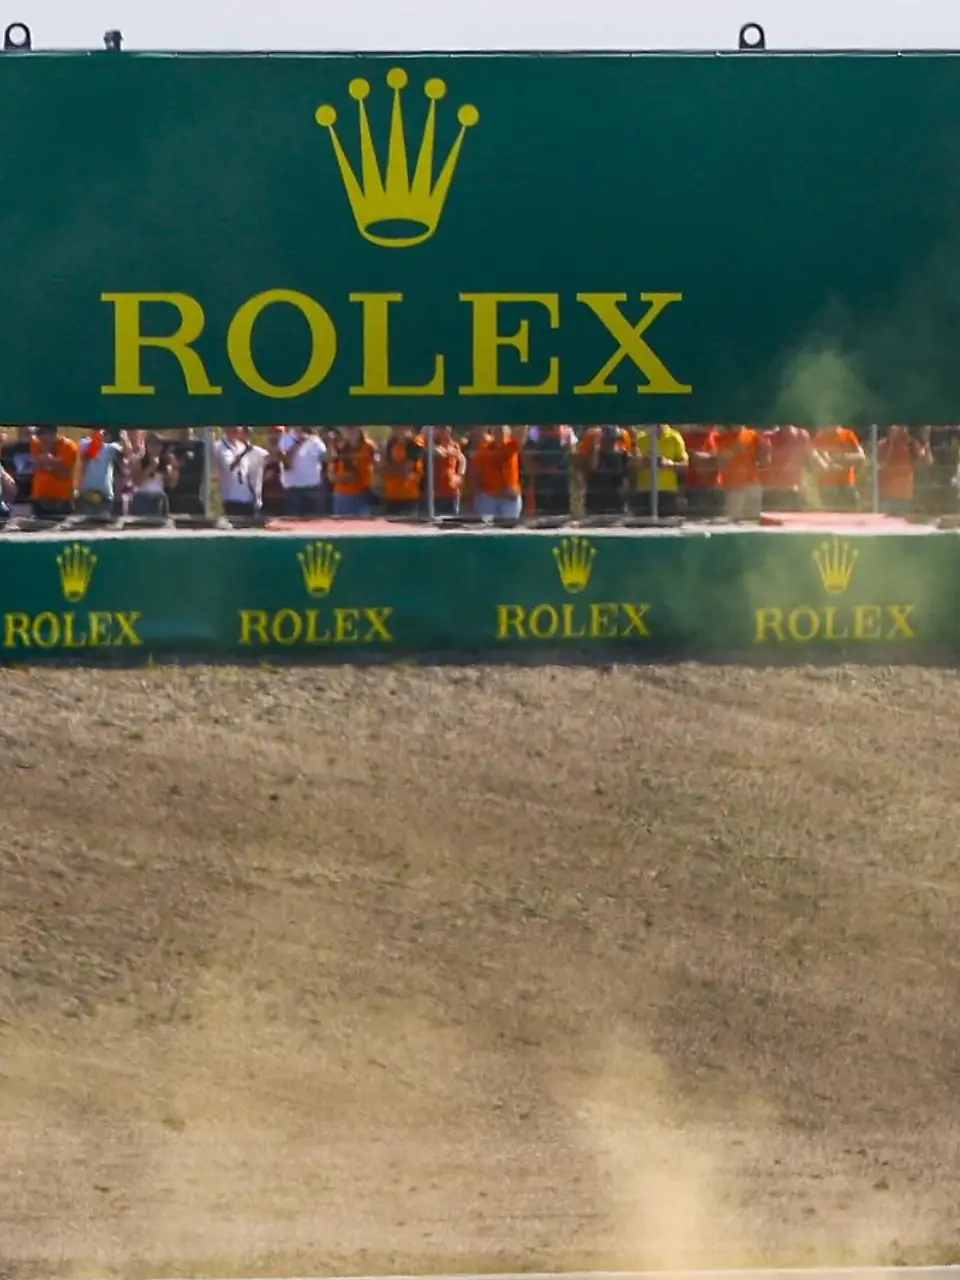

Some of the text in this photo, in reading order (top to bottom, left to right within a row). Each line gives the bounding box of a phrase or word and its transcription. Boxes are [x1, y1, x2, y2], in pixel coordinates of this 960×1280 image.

[100, 288, 693, 399] ROLEX
[3, 611, 143, 648] ROLEX
[239, 607, 395, 645] ROLEX
[499, 602, 652, 639] ROLEX
[755, 604, 916, 642] ROLEX
